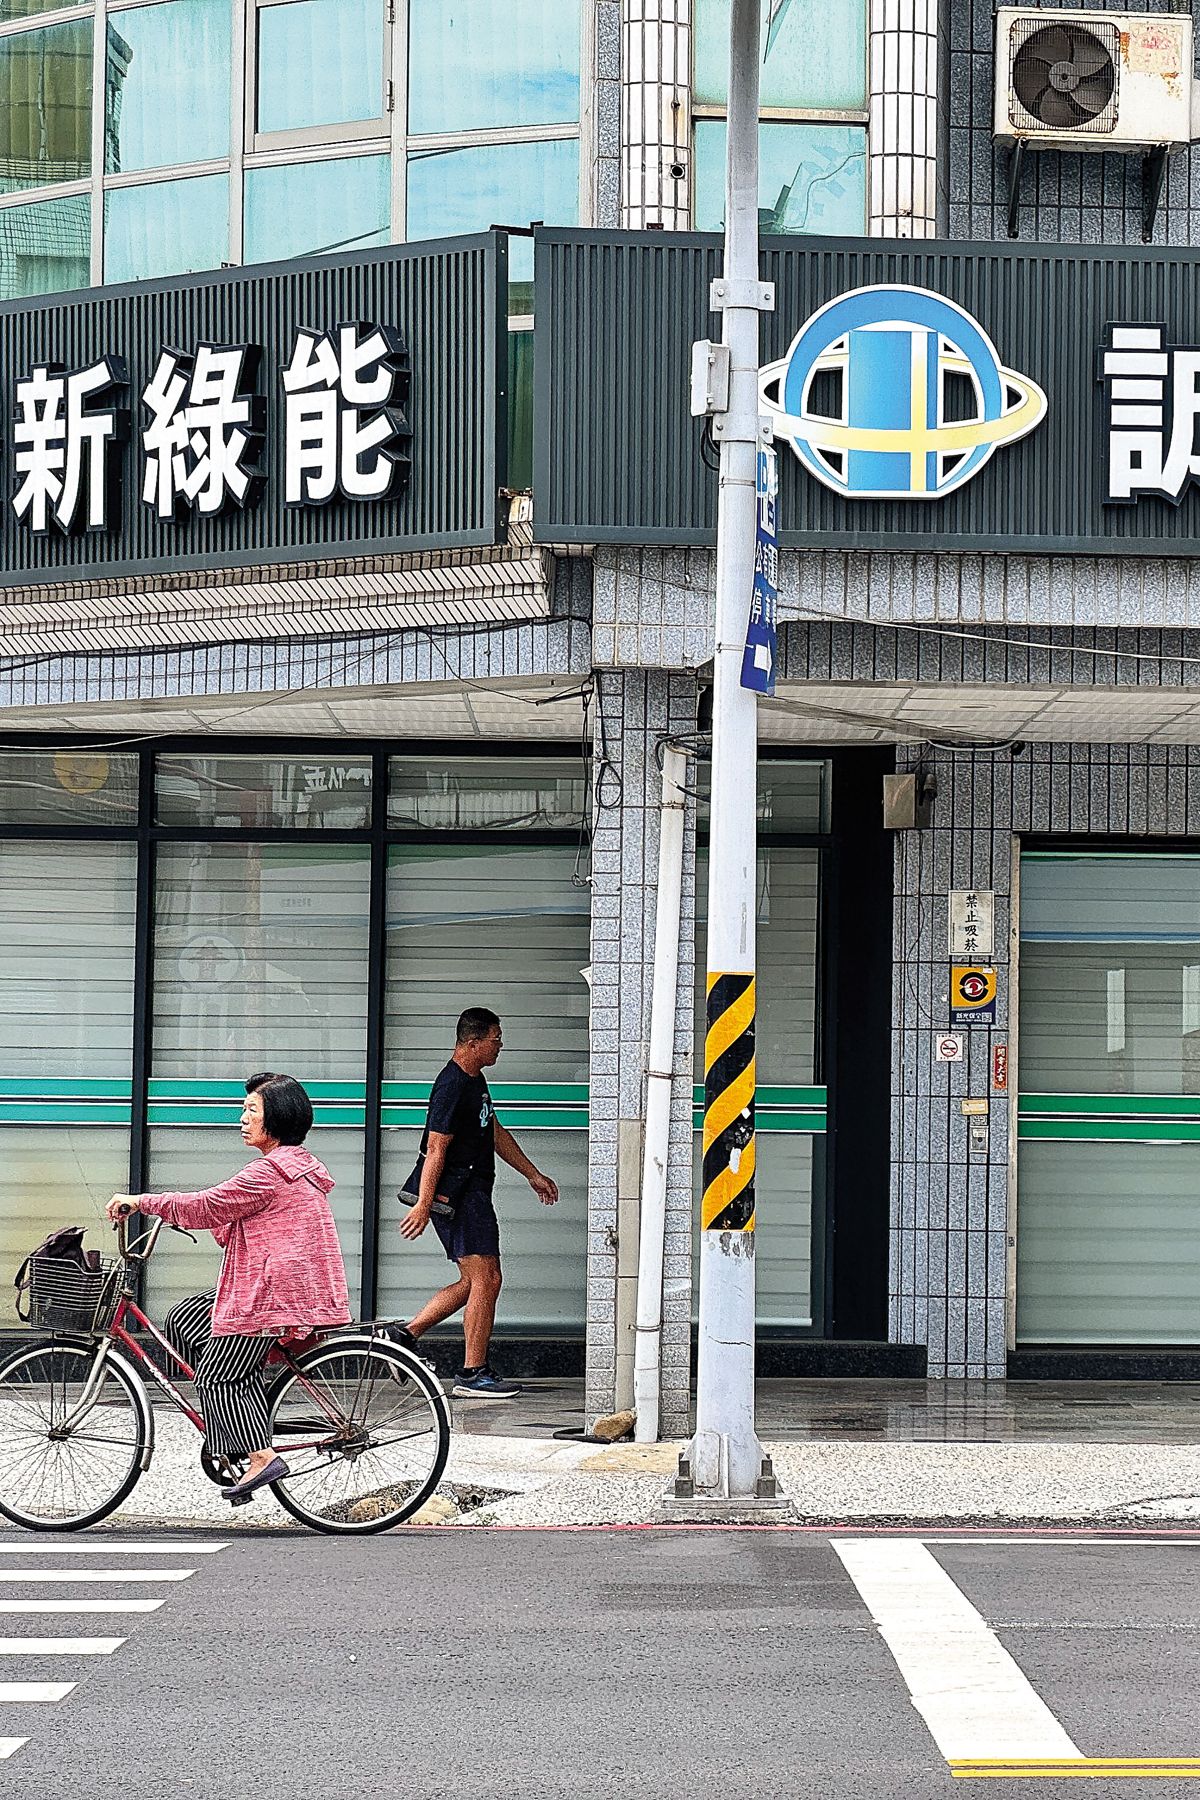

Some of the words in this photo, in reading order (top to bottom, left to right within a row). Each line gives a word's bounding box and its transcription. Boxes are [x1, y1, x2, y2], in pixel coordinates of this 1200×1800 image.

[12, 325, 396, 531] 新綠能
[964, 893, 979, 952] 禁止吸菸
